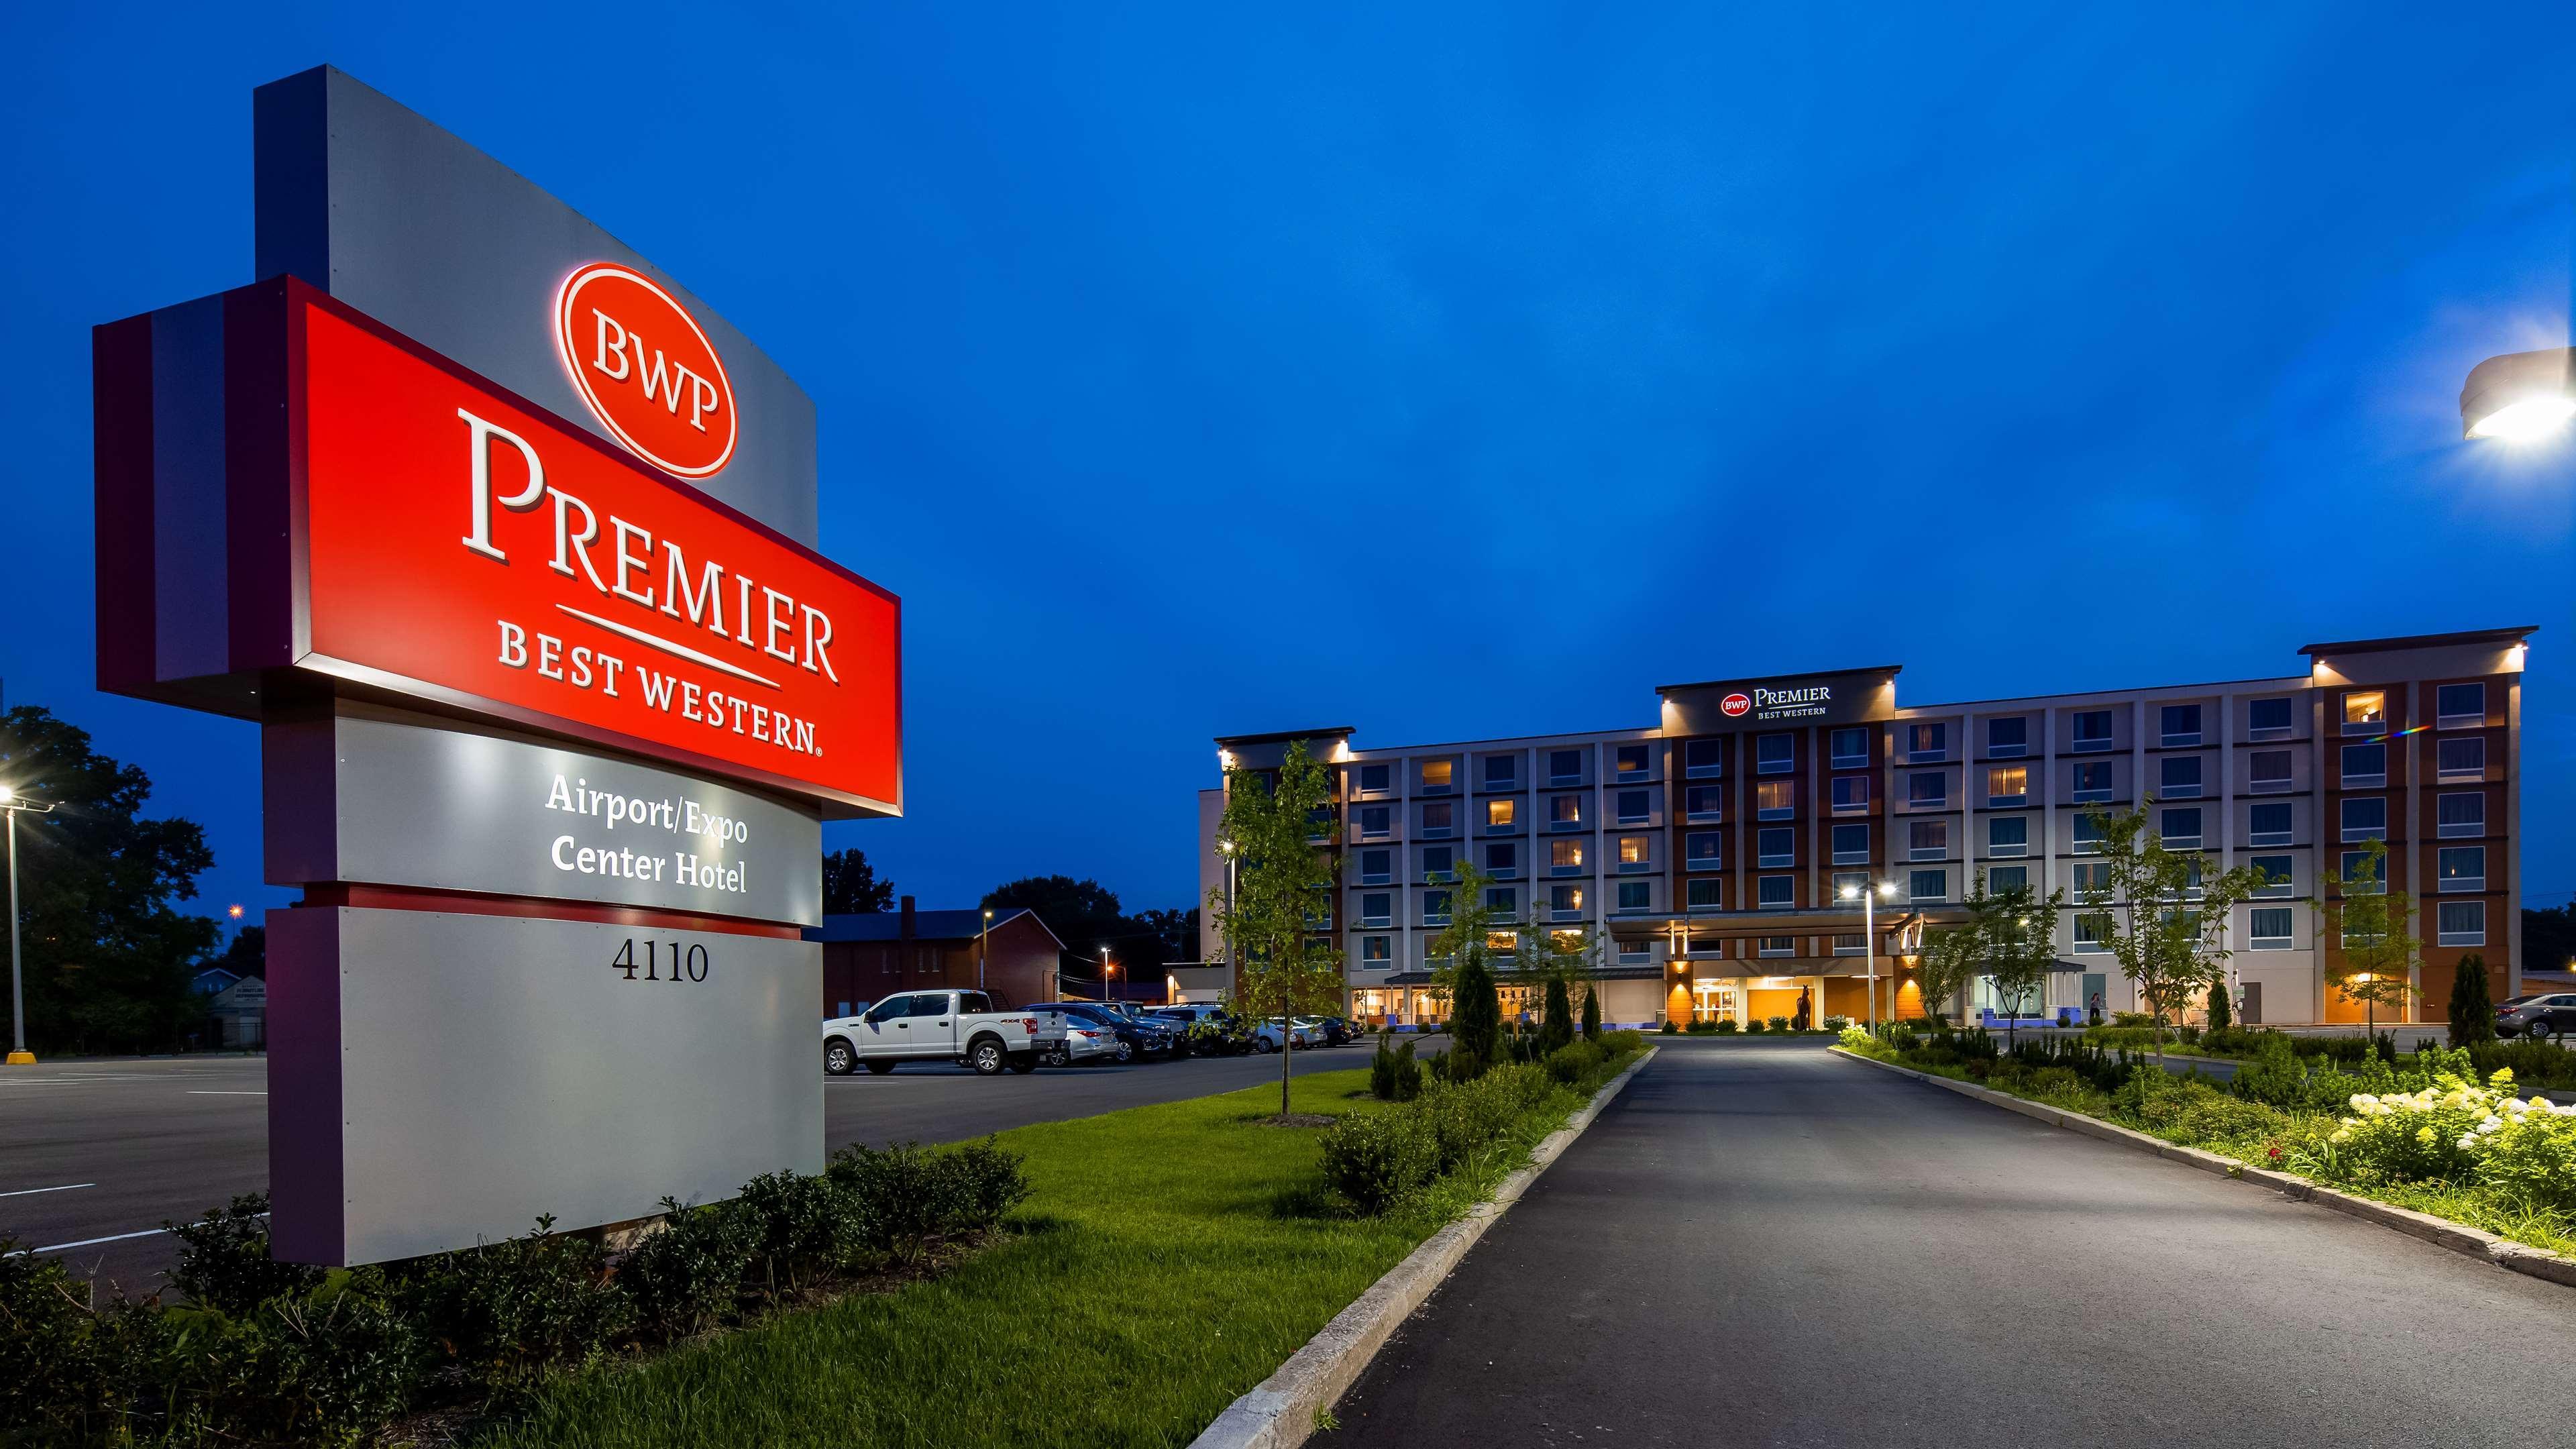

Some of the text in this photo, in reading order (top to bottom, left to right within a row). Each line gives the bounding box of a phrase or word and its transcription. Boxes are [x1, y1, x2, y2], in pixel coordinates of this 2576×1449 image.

[592, 307, 719, 432] BWP
[458, 407, 840, 684] PREMIER
[497, 620, 624, 697] BEST
[1725, 700, 1747, 710] BWP
[1753, 686, 1831, 707] PREMIER
[1758, 708, 1825, 719] BEST WESTERN
[545, 773, 748, 848] Airport/Expo
[551, 835, 747, 894] Center Hotel
[611, 938, 709, 983] 4110
